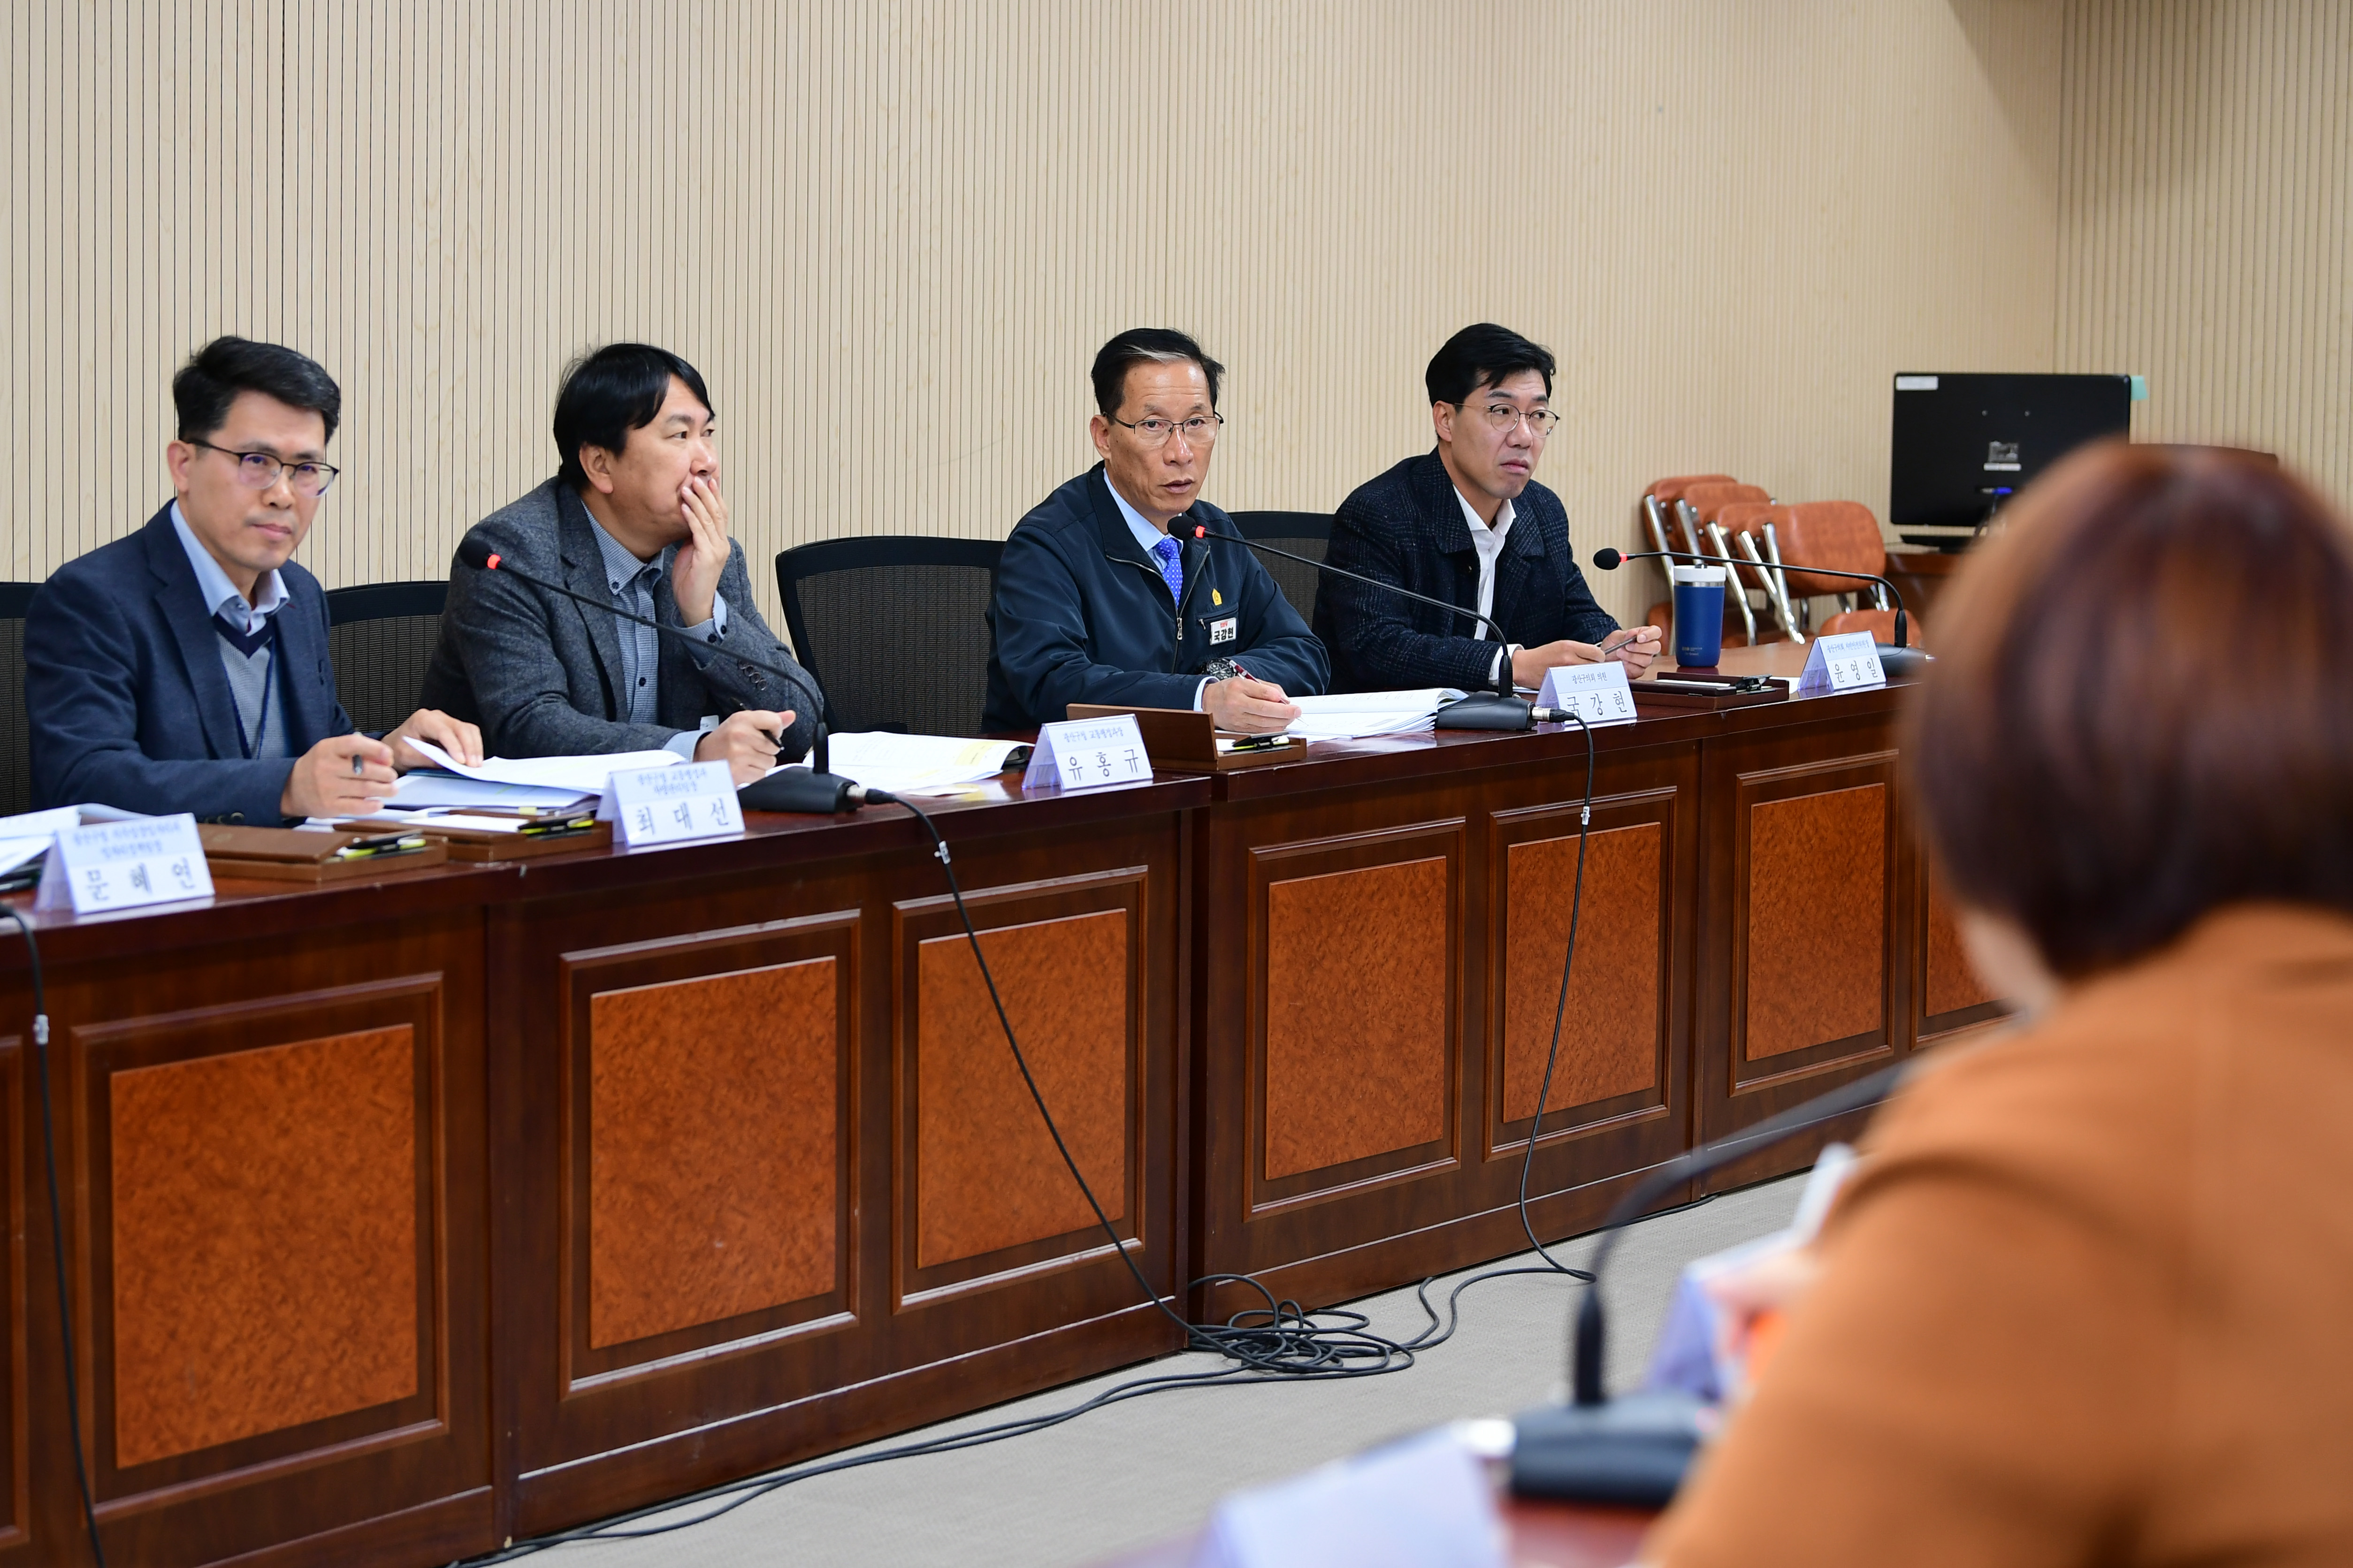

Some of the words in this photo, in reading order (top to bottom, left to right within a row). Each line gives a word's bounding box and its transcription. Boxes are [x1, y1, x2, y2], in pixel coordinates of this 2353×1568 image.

[1215, 627, 1233, 641] 국강현
[1572, 673, 1596, 684] 광산구의회
[1597, 672, 1608, 682] 의원
[1063, 731, 1087, 742] 광산구청
[1089, 727, 1123, 738] 교통행정과장
